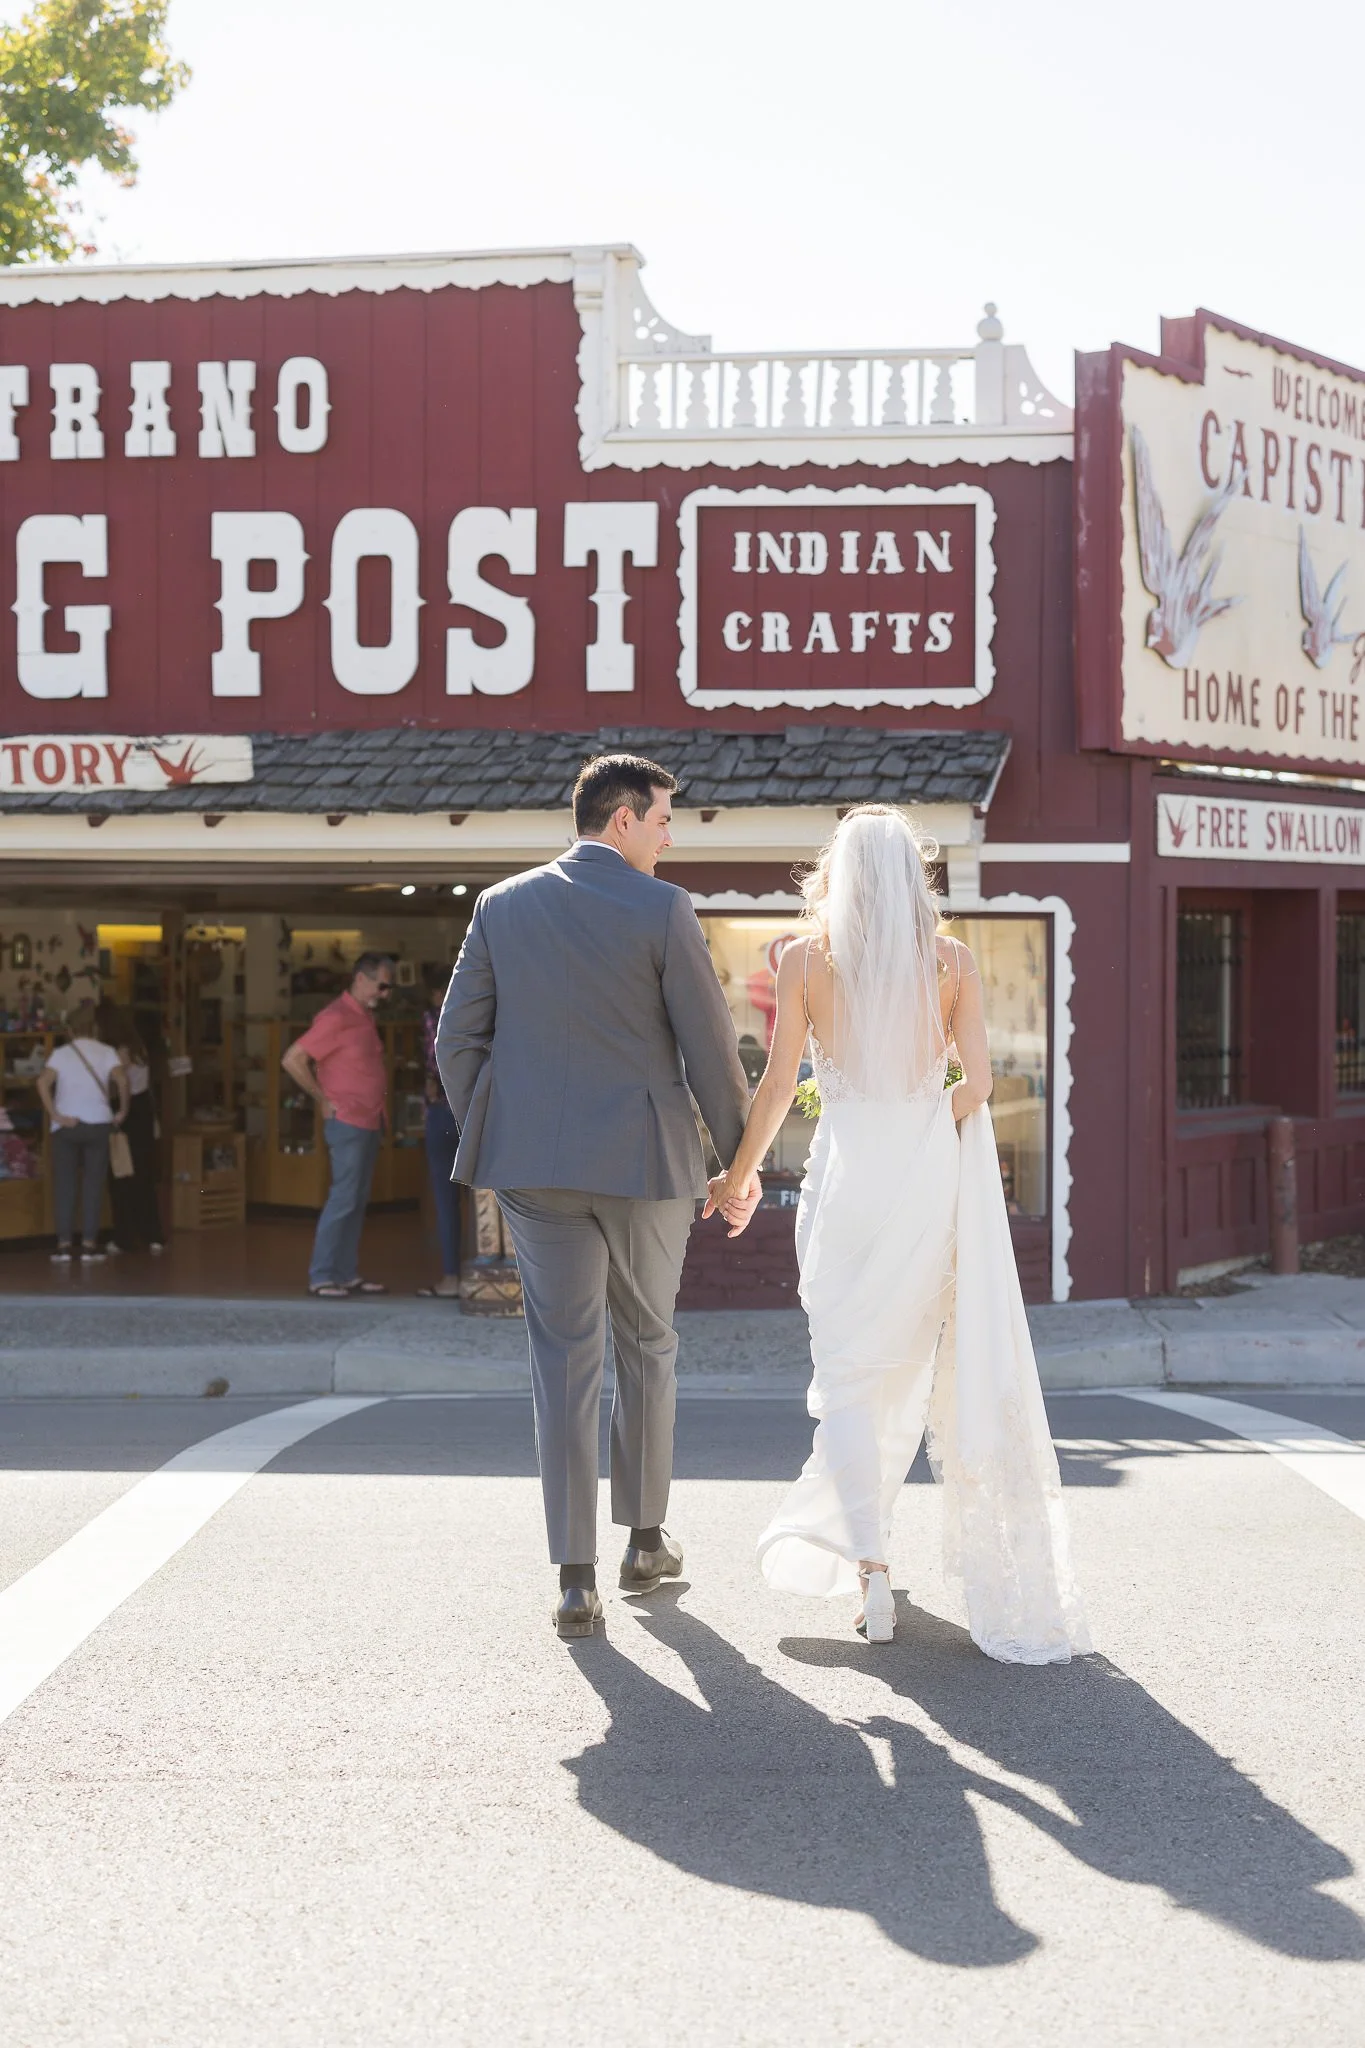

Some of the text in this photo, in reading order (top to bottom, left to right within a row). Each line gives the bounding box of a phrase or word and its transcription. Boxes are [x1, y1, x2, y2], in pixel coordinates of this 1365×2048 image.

[0, 356, 332, 461] TRANO
[732, 530, 954, 575] INDIAN
[11, 501, 659, 699] G POST
[722, 610, 955, 654] CRAFTS
[1184, 668, 1359, 741] HOME OF THE
[1, 742, 133, 786] TORY
[1196, 804, 1362, 855] FREE SWALLOW
